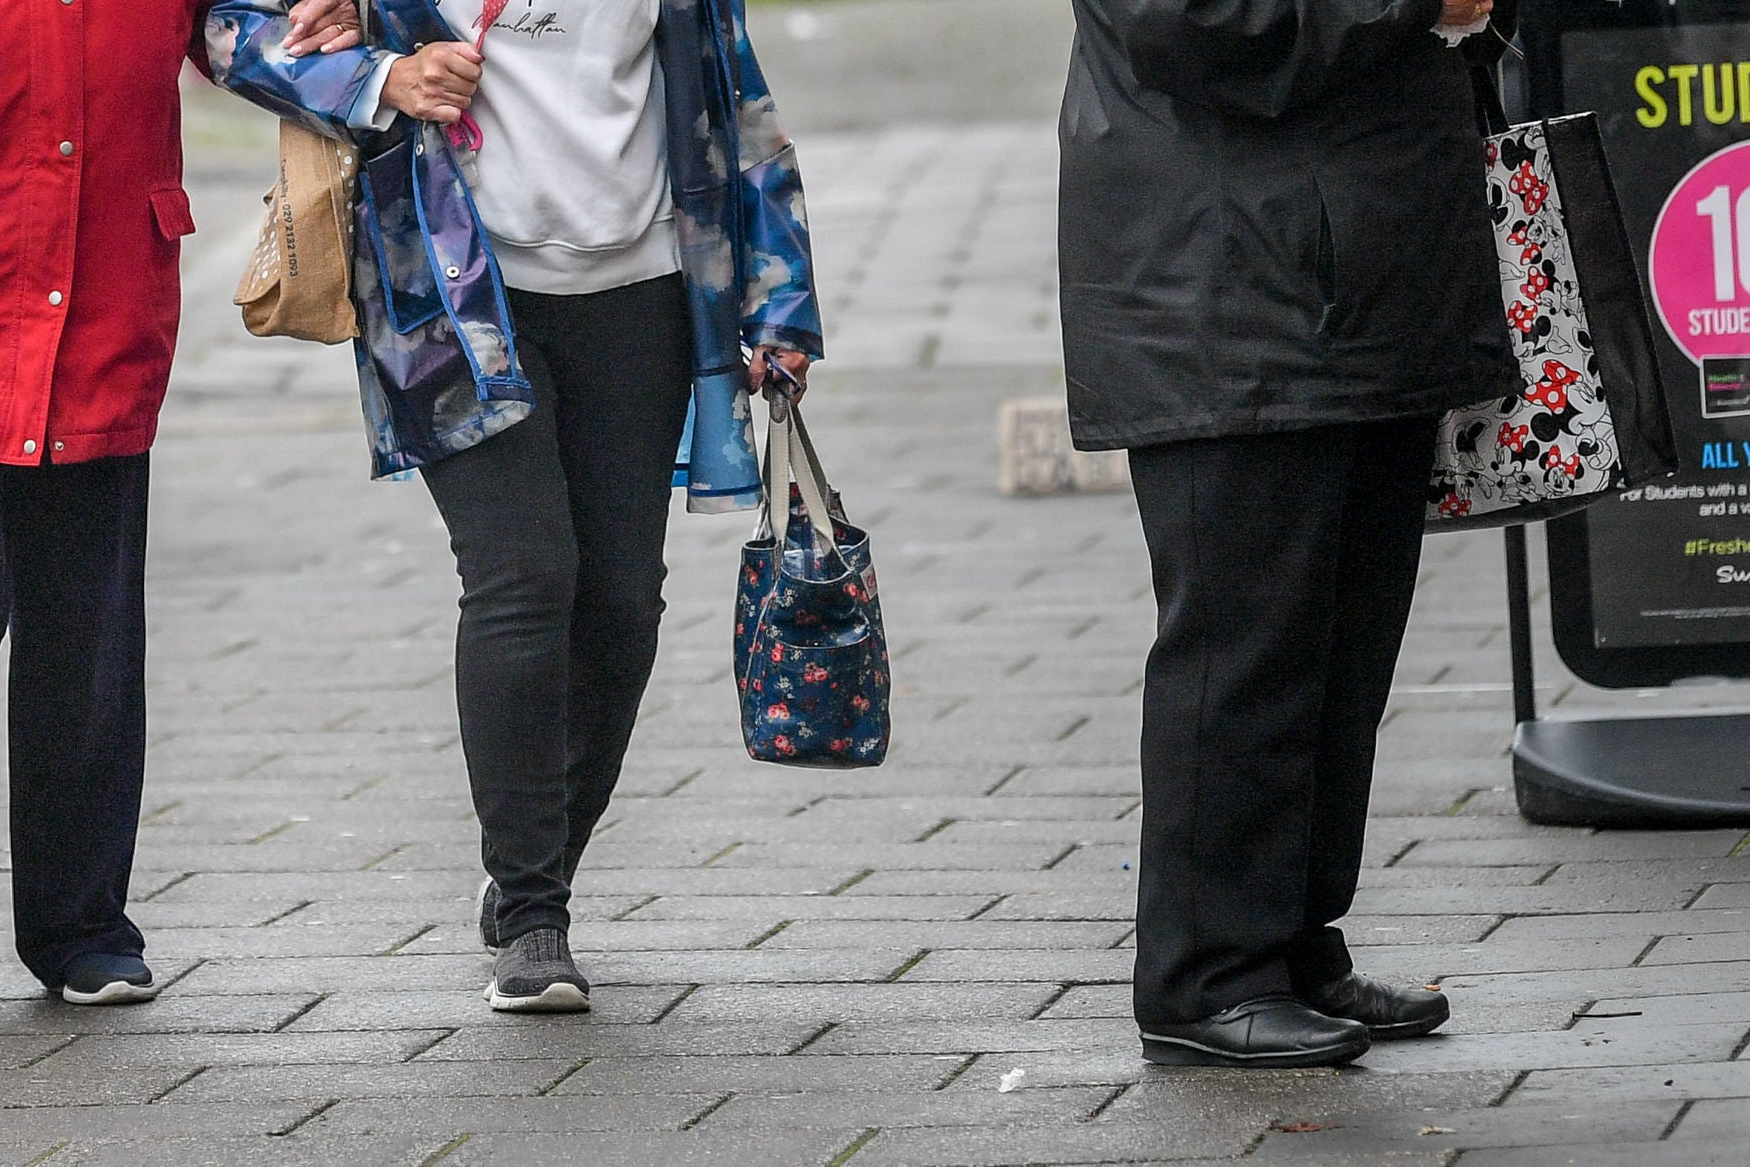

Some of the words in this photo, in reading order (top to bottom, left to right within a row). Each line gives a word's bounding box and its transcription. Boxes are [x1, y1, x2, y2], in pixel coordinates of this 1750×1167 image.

[283, 204, 292, 224] 029
[1701, 441, 1739, 470] ALL
[1644, 484, 1705, 501] Students
[1706, 481, 1736, 497] with
[1738, 484, 1747, 496] a
[1699, 500, 1726, 517] and
[1728, 503, 1738, 515] a
[1684, 536, 1750, 556] #Fresh
